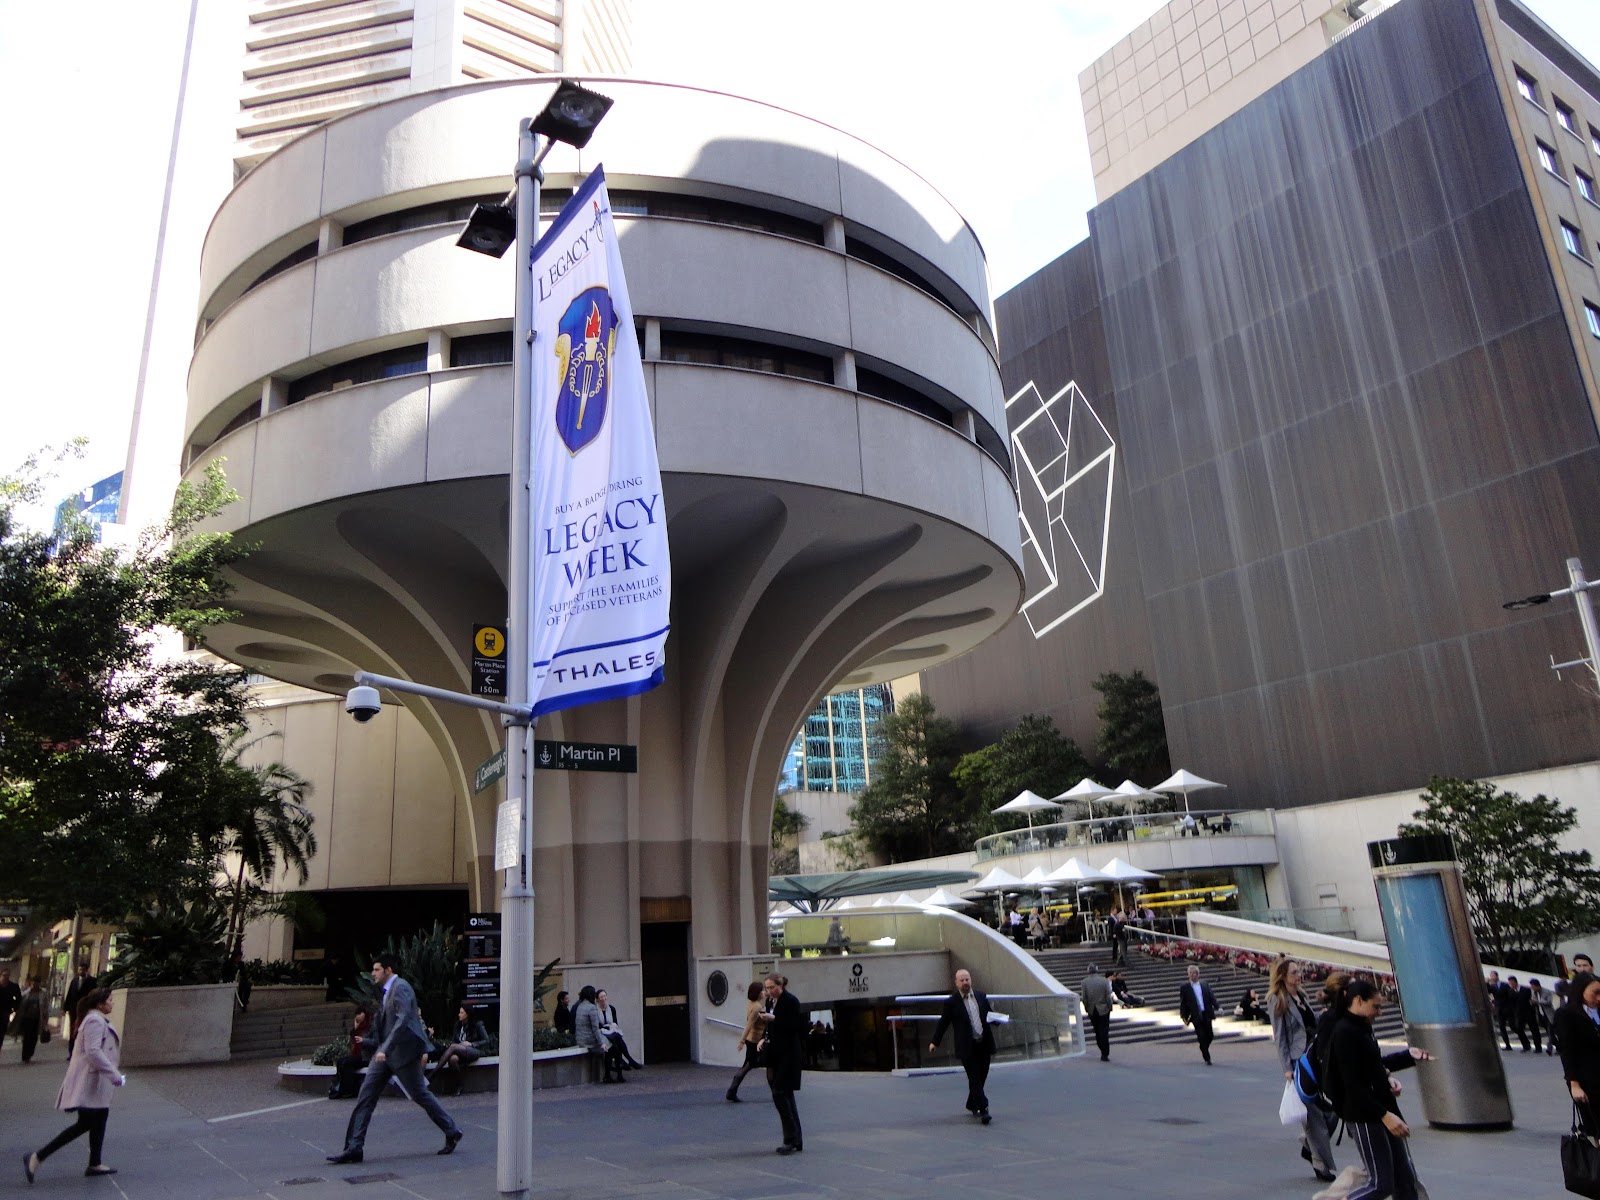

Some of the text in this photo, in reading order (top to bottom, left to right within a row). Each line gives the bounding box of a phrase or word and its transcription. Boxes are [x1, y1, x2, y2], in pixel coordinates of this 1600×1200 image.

[538, 231, 590, 302] LEGACY
[555, 502, 574, 514] BUY
[576, 501, 582, 510] A
[544, 494, 660, 556] LEGACY
[562, 538, 649, 589] WEEK
[587, 586, 607, 598] THE
[611, 575, 659, 594] FAMILIES
[546, 586, 663, 626] OF DCEASED VETERANS
[553, 651, 655, 683] THALES
[480, 685, 500, 693] 150m
[560, 745, 620, 761] Martin Pl
[849, 976, 868, 987] MLC
